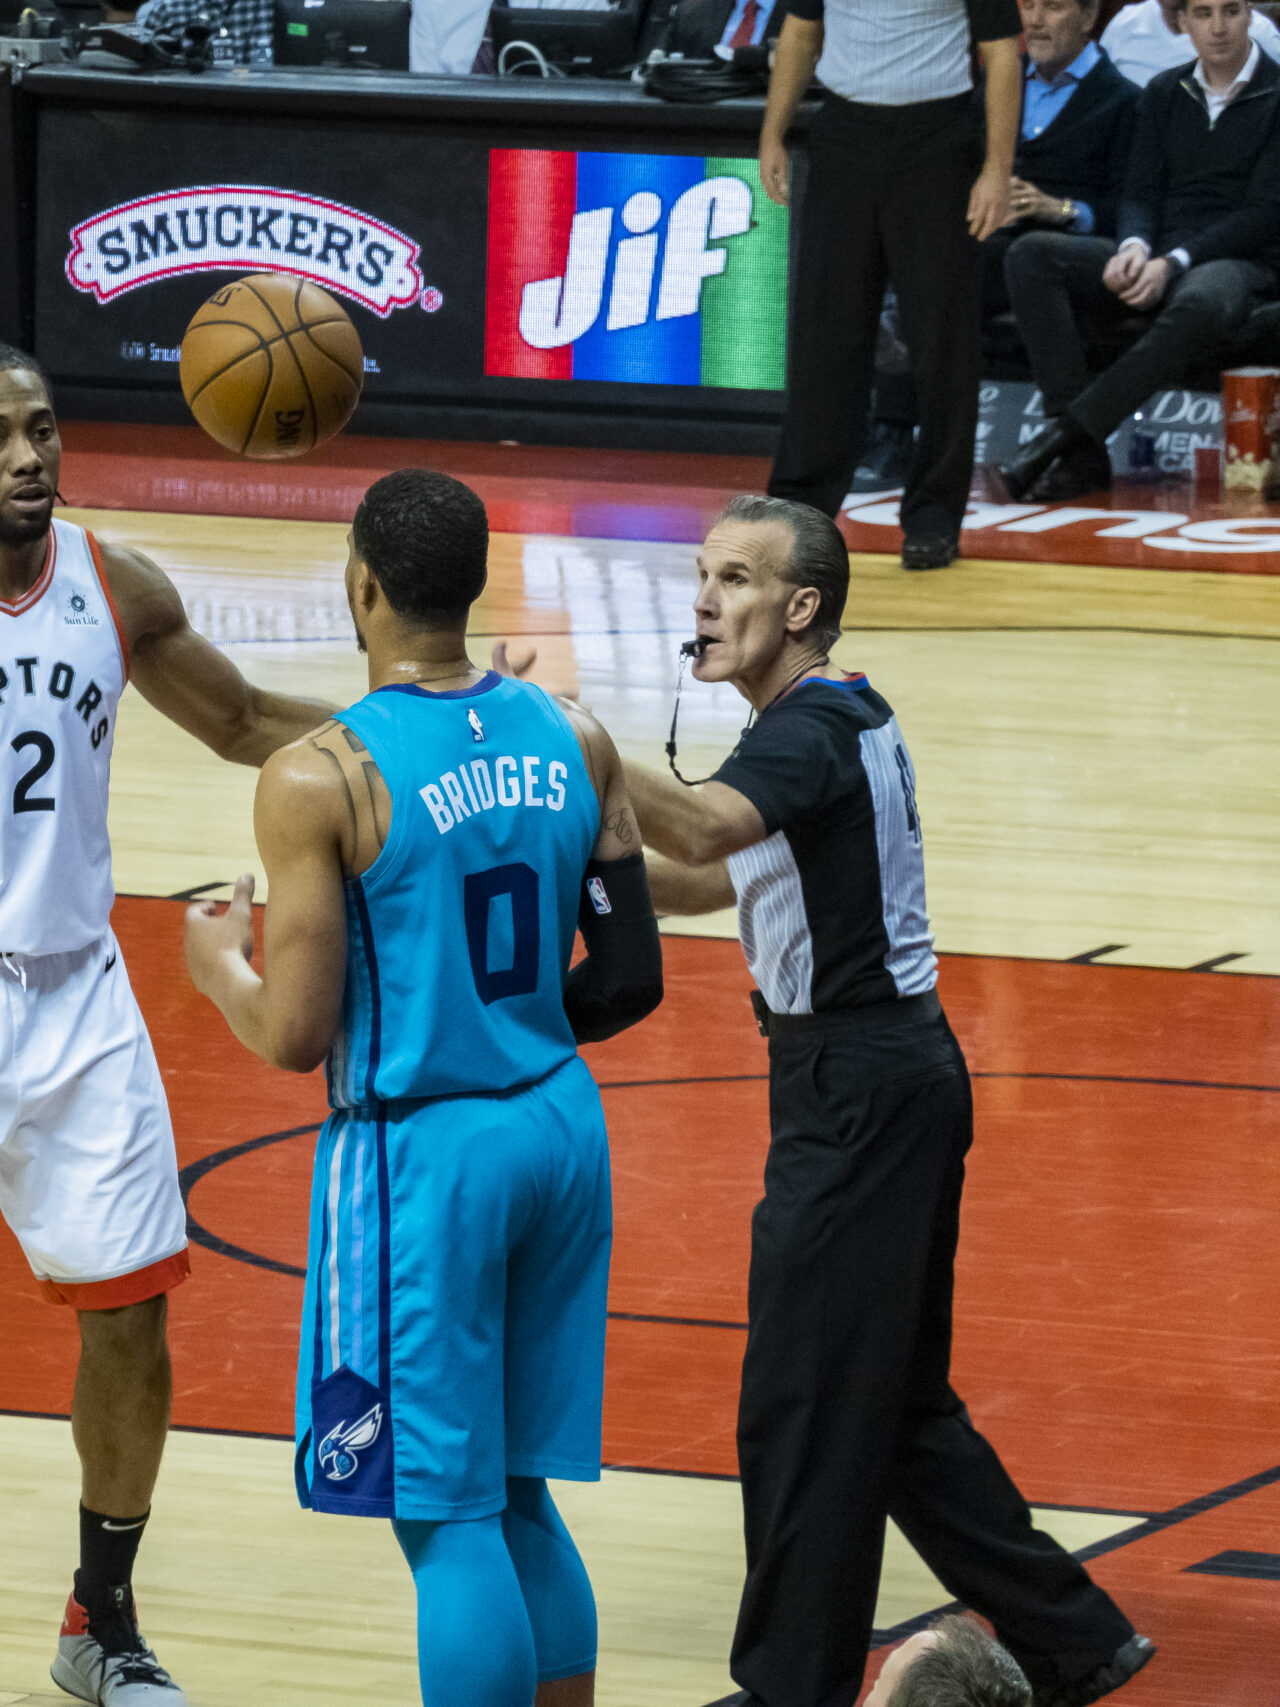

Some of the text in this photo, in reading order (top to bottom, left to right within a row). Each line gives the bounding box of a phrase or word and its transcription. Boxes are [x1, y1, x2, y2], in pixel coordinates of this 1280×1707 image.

[96, 204, 395, 288] SMUCKER'S
[518, 175, 754, 350] Jif
[64, 616, 99, 626] Sun Life
[10, 730, 56, 815] 2
[418, 755, 568, 836] BRIDGES
[463, 861, 541, 1007] 0
